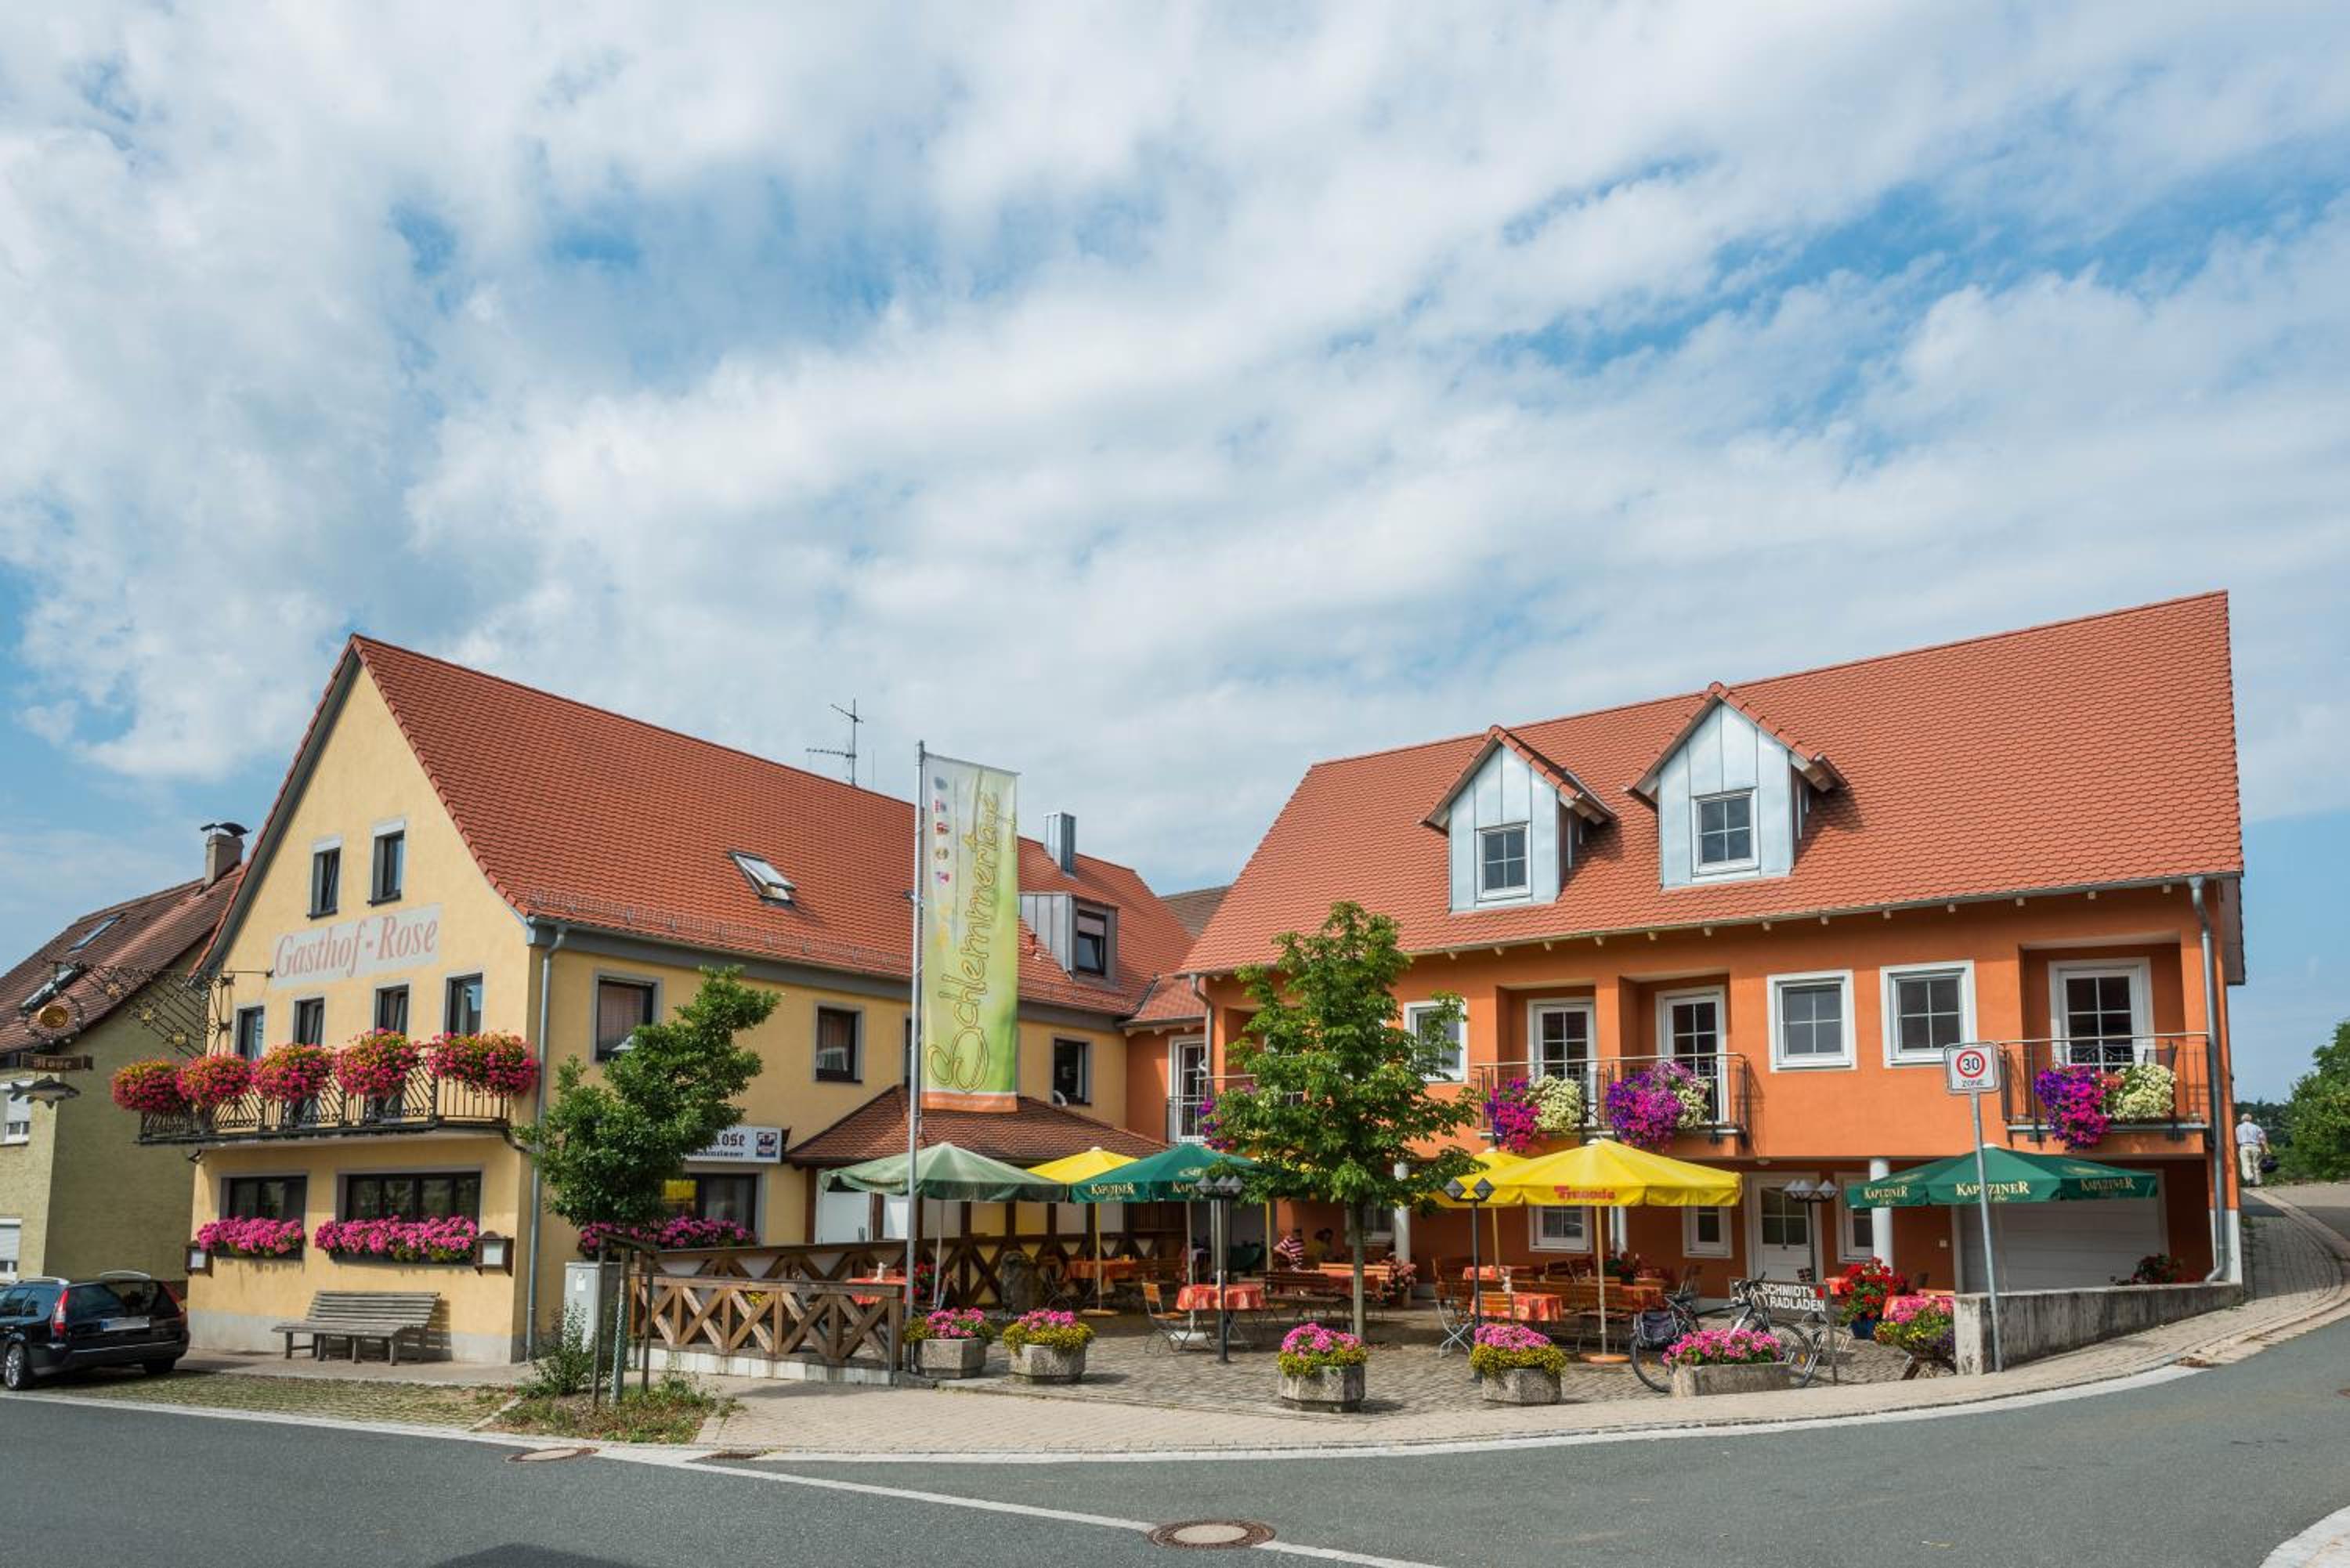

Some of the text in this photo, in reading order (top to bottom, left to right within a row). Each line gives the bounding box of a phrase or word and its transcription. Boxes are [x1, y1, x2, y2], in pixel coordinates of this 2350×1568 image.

[1962, 1057, 1980, 1071] 30
[715, 1133, 746, 1147] ose
[1956, 1180, 2030, 1196] KAPZINER
[1770, 1296, 1826, 1312] RADLADEN
